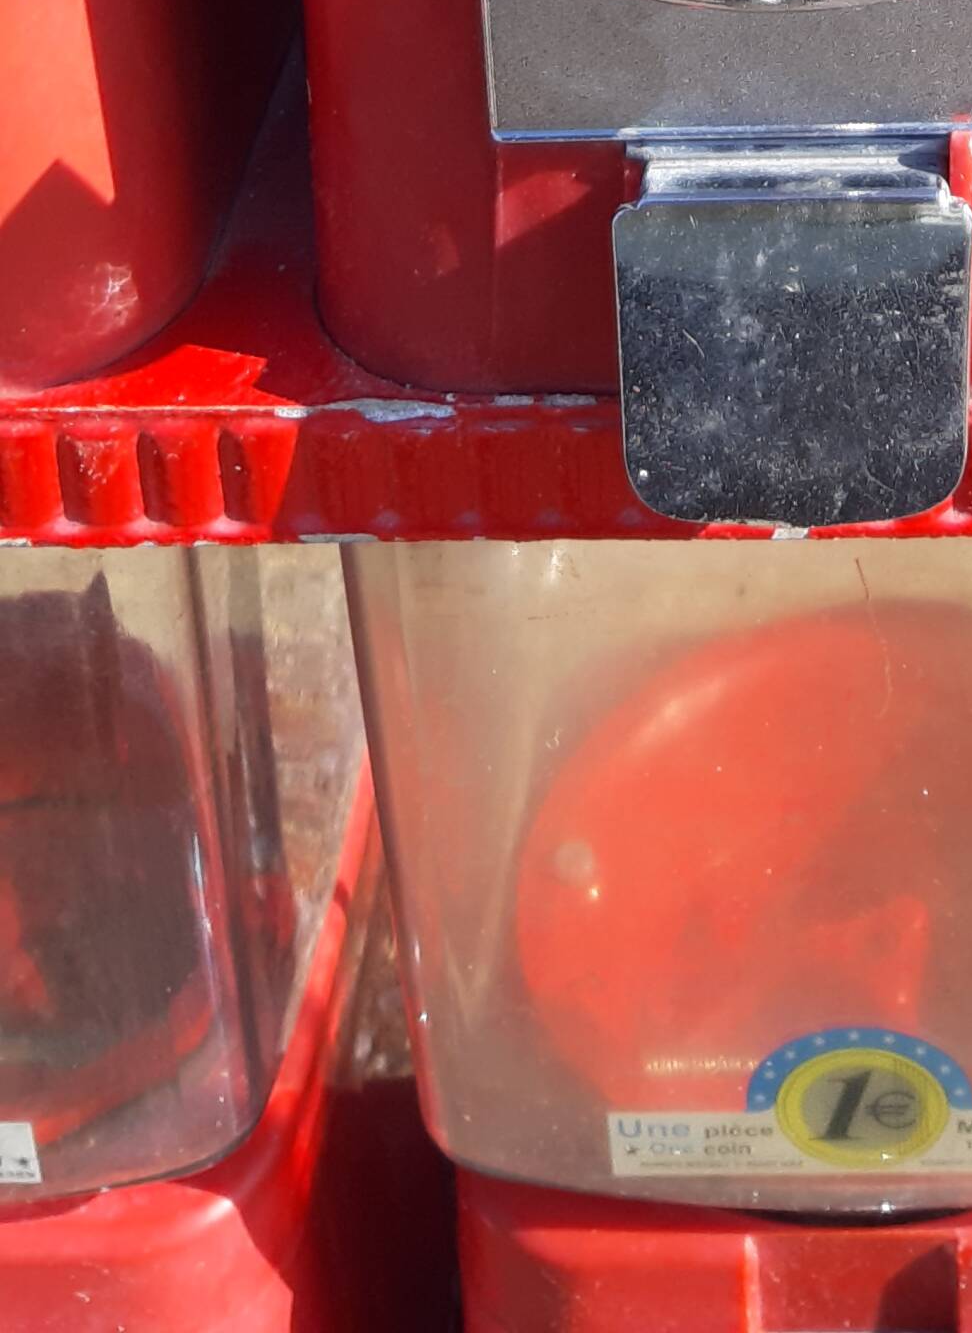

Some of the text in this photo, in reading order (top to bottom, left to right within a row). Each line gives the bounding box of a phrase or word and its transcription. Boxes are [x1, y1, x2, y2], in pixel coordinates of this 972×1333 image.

[616, 1118, 691, 1139] Une
[650, 1140, 753, 1156] One coin
